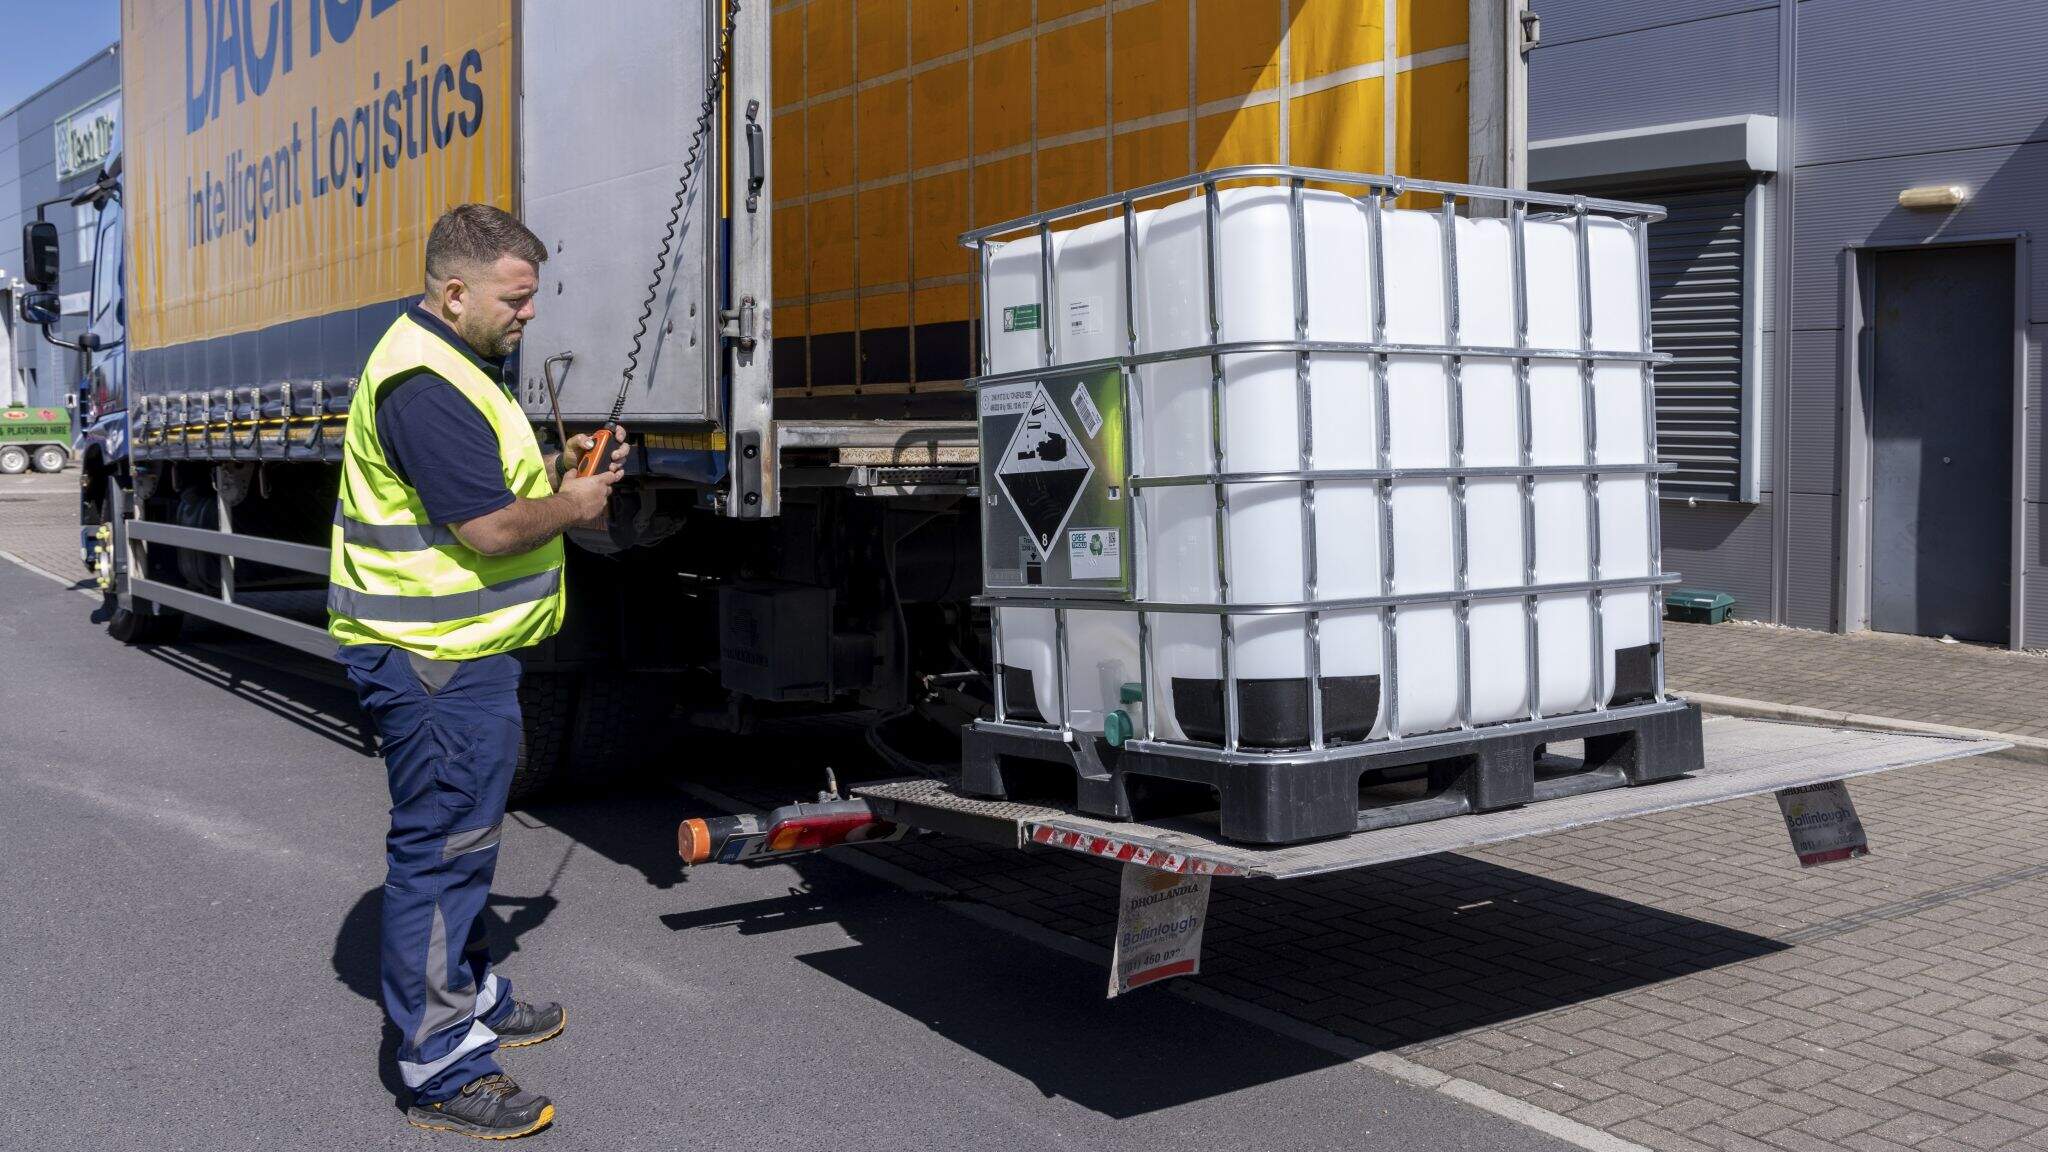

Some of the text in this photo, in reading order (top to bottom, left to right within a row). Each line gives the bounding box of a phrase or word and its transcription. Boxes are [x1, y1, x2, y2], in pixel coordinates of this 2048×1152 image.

[185, 0, 399, 135] DAC
[187, 45, 484, 249] Intelligent Logistics
[7, 425, 47, 435] PLATFORM
[50, 425, 66, 434] HIRE
[1041, 533, 1048, 547] 8
[1787, 807, 1852, 828] Ballinlough
[1131, 883, 1200, 910] DHOLLANDIA
[1122, 915, 1198, 948] Ballinlough
